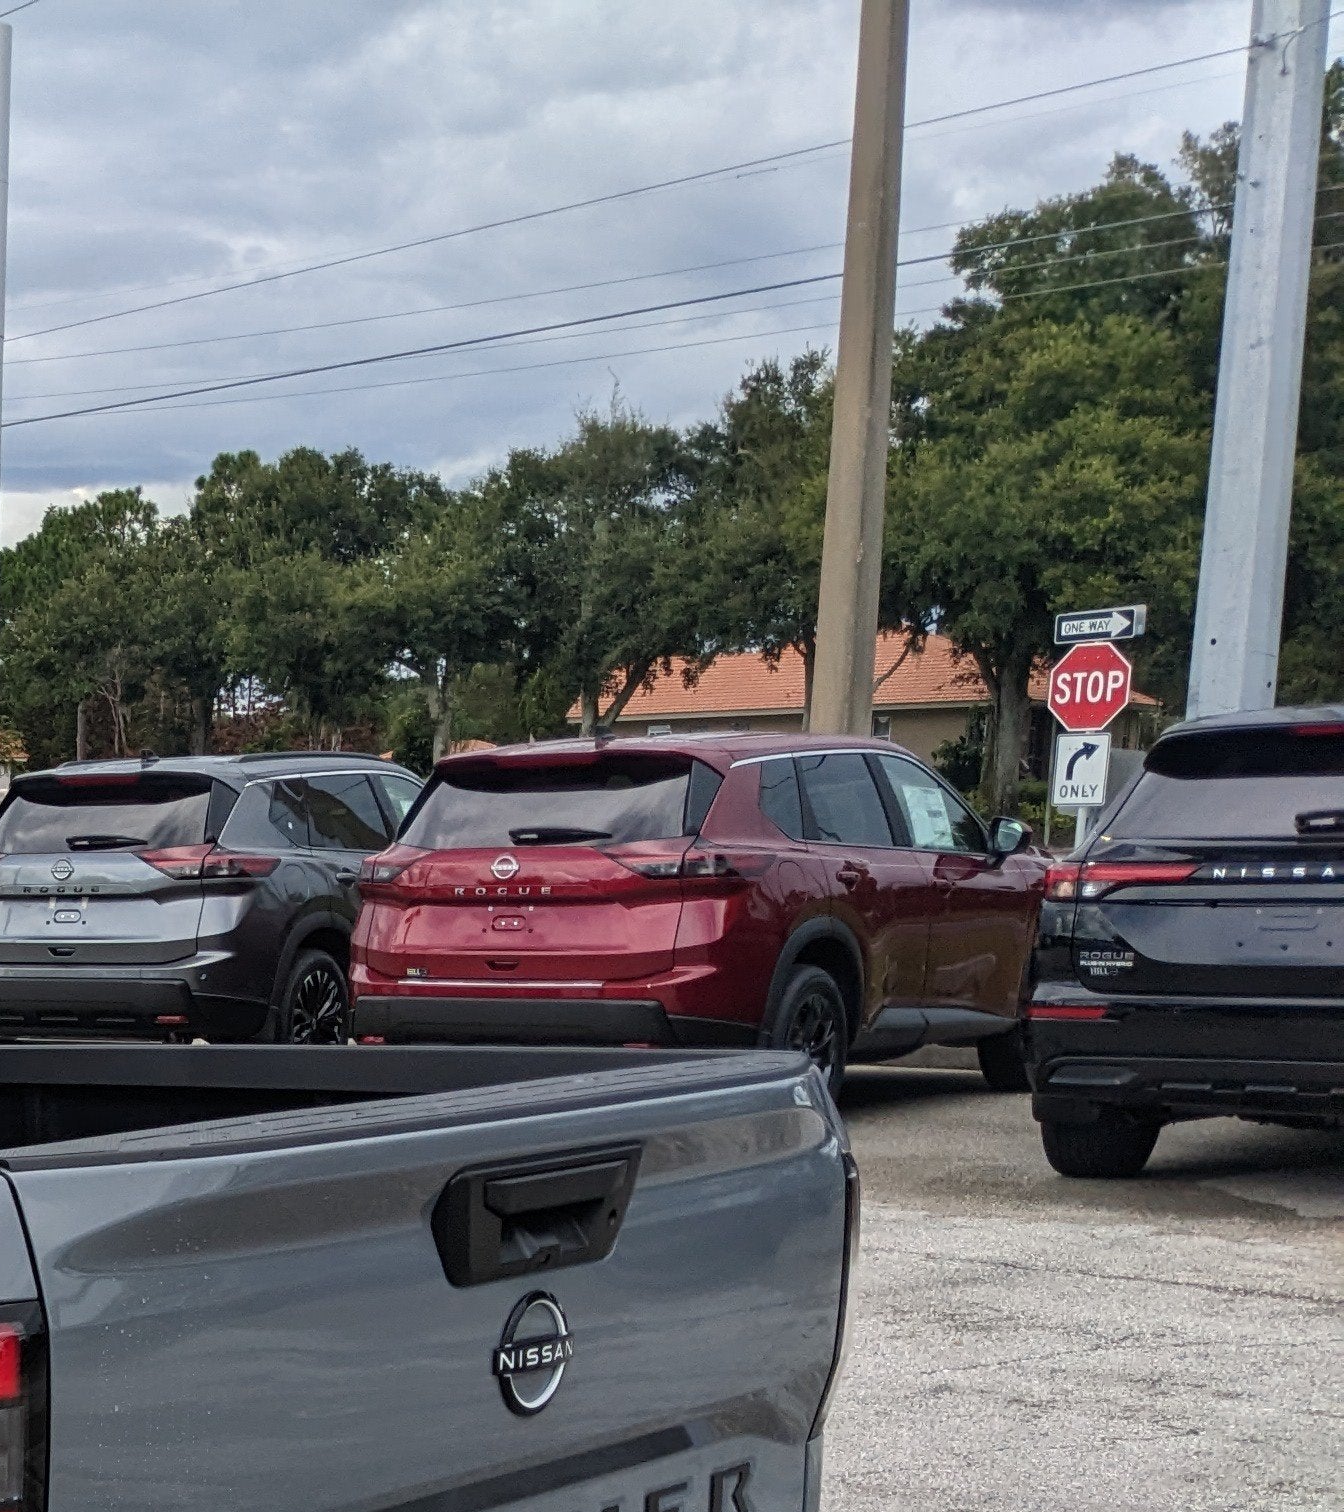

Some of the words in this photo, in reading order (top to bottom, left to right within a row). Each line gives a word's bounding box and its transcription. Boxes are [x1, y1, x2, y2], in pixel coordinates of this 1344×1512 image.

[1064, 621, 1085, 635] ONE
[1088, 619, 1111, 632] WAY
[1054, 670, 1124, 705] STOP
[1059, 784, 1099, 798] ONLY
[454, 886, 552, 896] ROGUE
[1079, 951, 1135, 960] ROGUE
[498, 1340, 573, 1371] NISSAN
